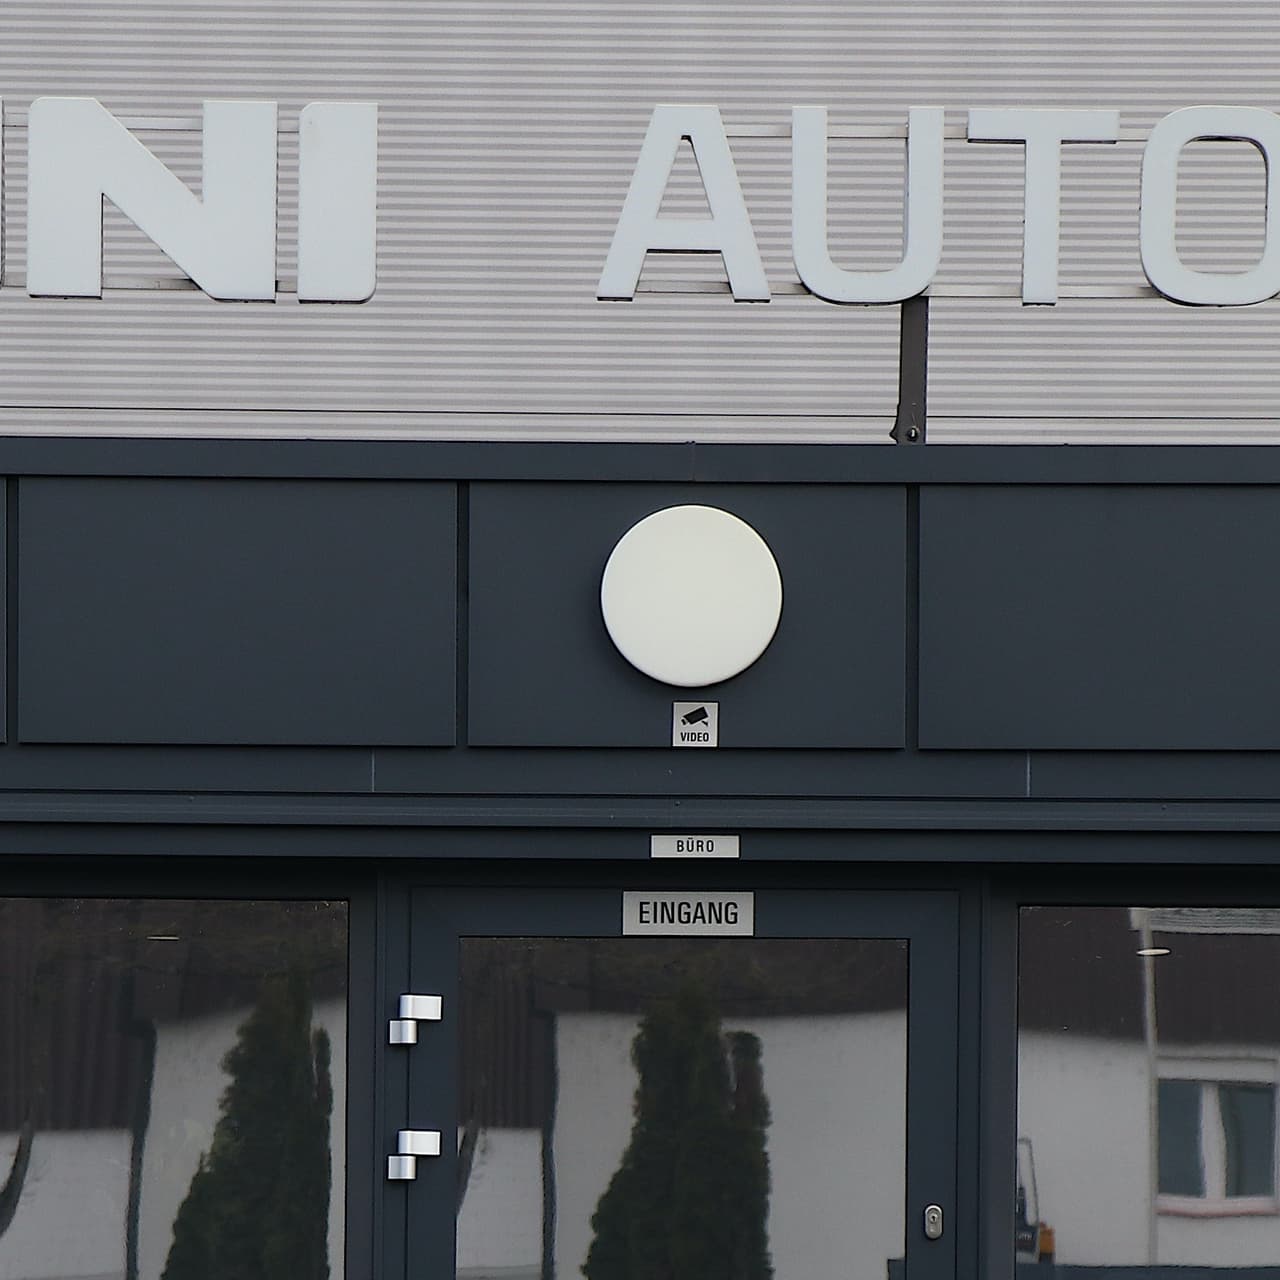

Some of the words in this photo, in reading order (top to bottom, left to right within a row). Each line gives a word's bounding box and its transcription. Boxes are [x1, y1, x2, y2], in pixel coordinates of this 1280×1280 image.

[679, 731, 710, 743] VIDEO
[676, 837, 715, 853] BÜRO
[638, 901, 739, 925] EINGANG
